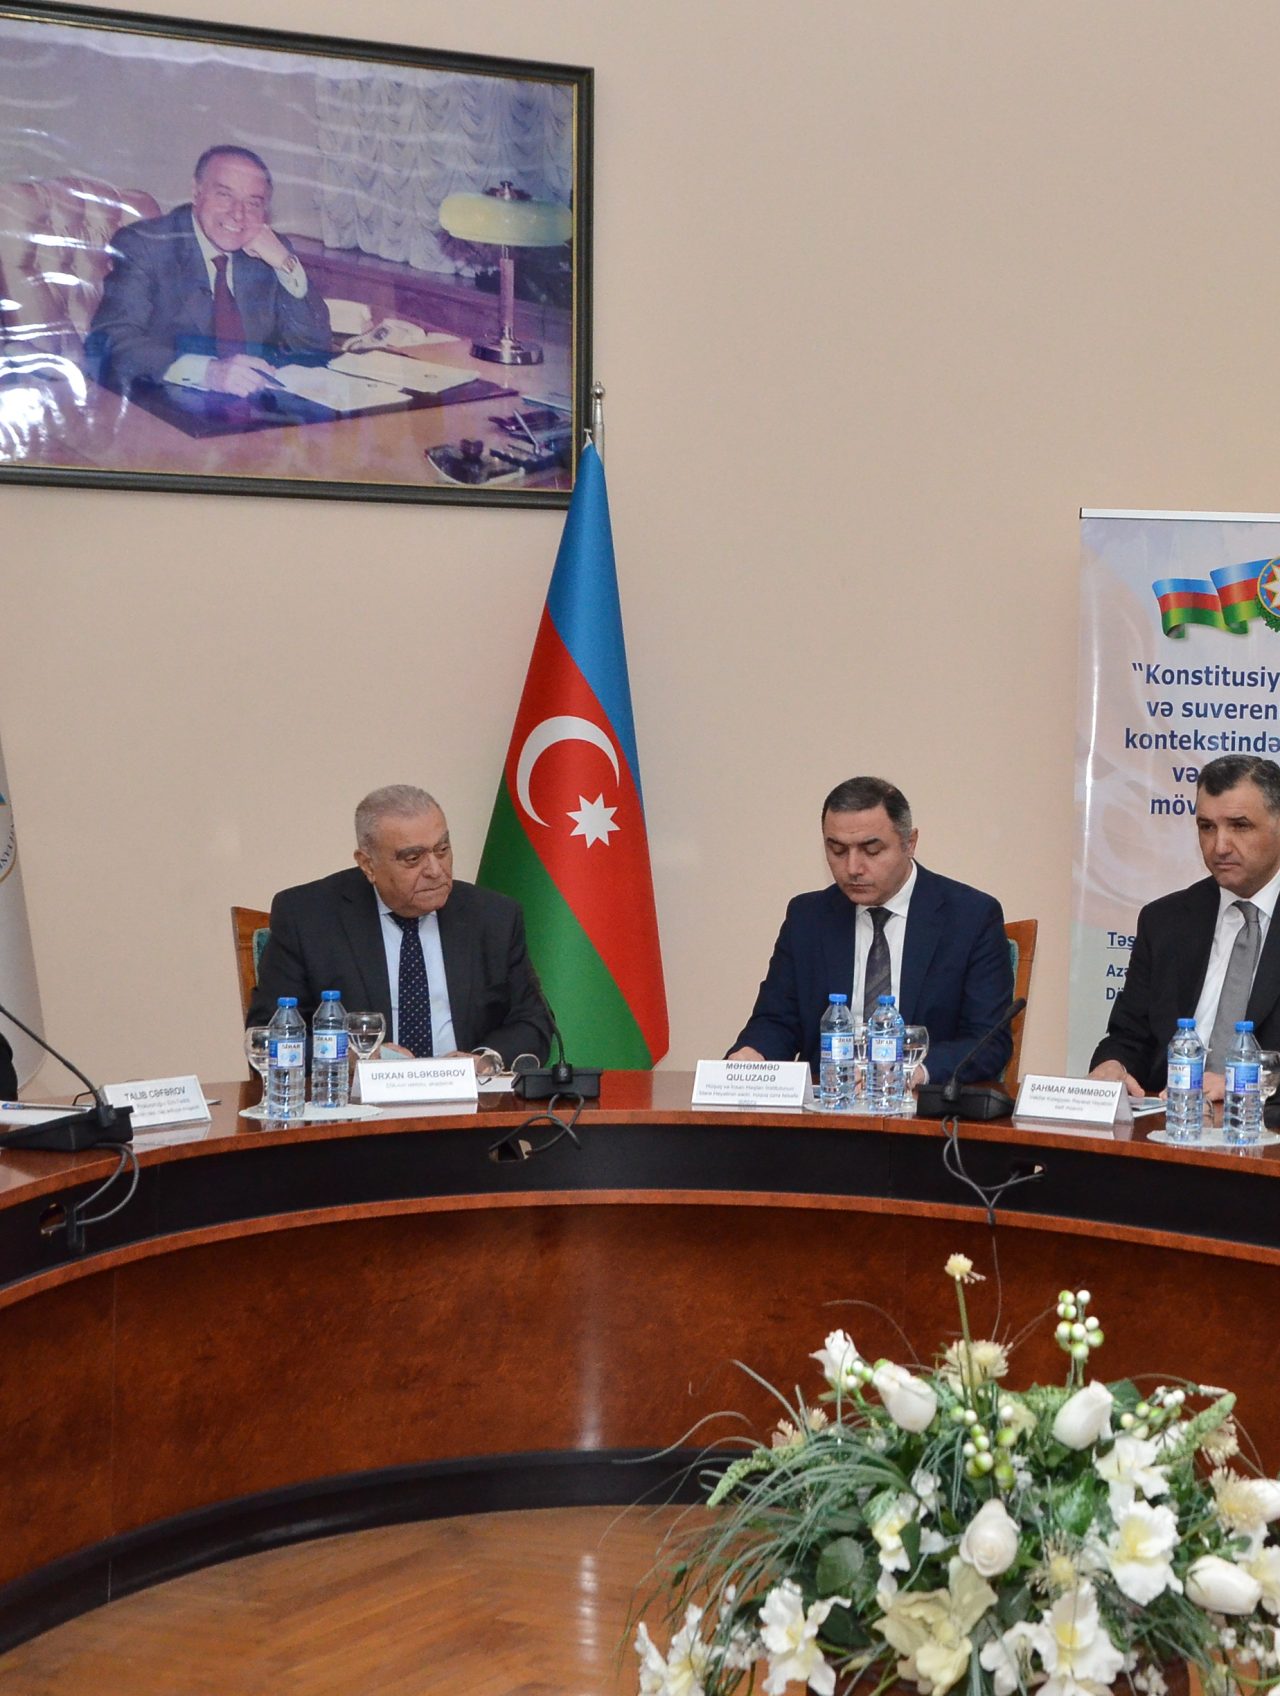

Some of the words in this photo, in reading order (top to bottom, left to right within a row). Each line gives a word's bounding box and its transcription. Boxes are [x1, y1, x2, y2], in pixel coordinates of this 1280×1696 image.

[1147, 700, 1173, 718] və
[1172, 766, 1198, 783] və
[1150, 795, 1198, 815] möv
[1106, 931, 1137, 950] Təş
[371, 1071, 405, 1080] URXAN
[407, 1069, 466, 1079] ƏLƏKBƏROV
[725, 1063, 780, 1071] MƏHƏMMƏD
[726, 1074, 776, 1083] QULUZADƏ
[1031, 1083, 1066, 1093] ŞAHMAR
[1067, 1088, 1117, 1098] MƏMMƏDOV
